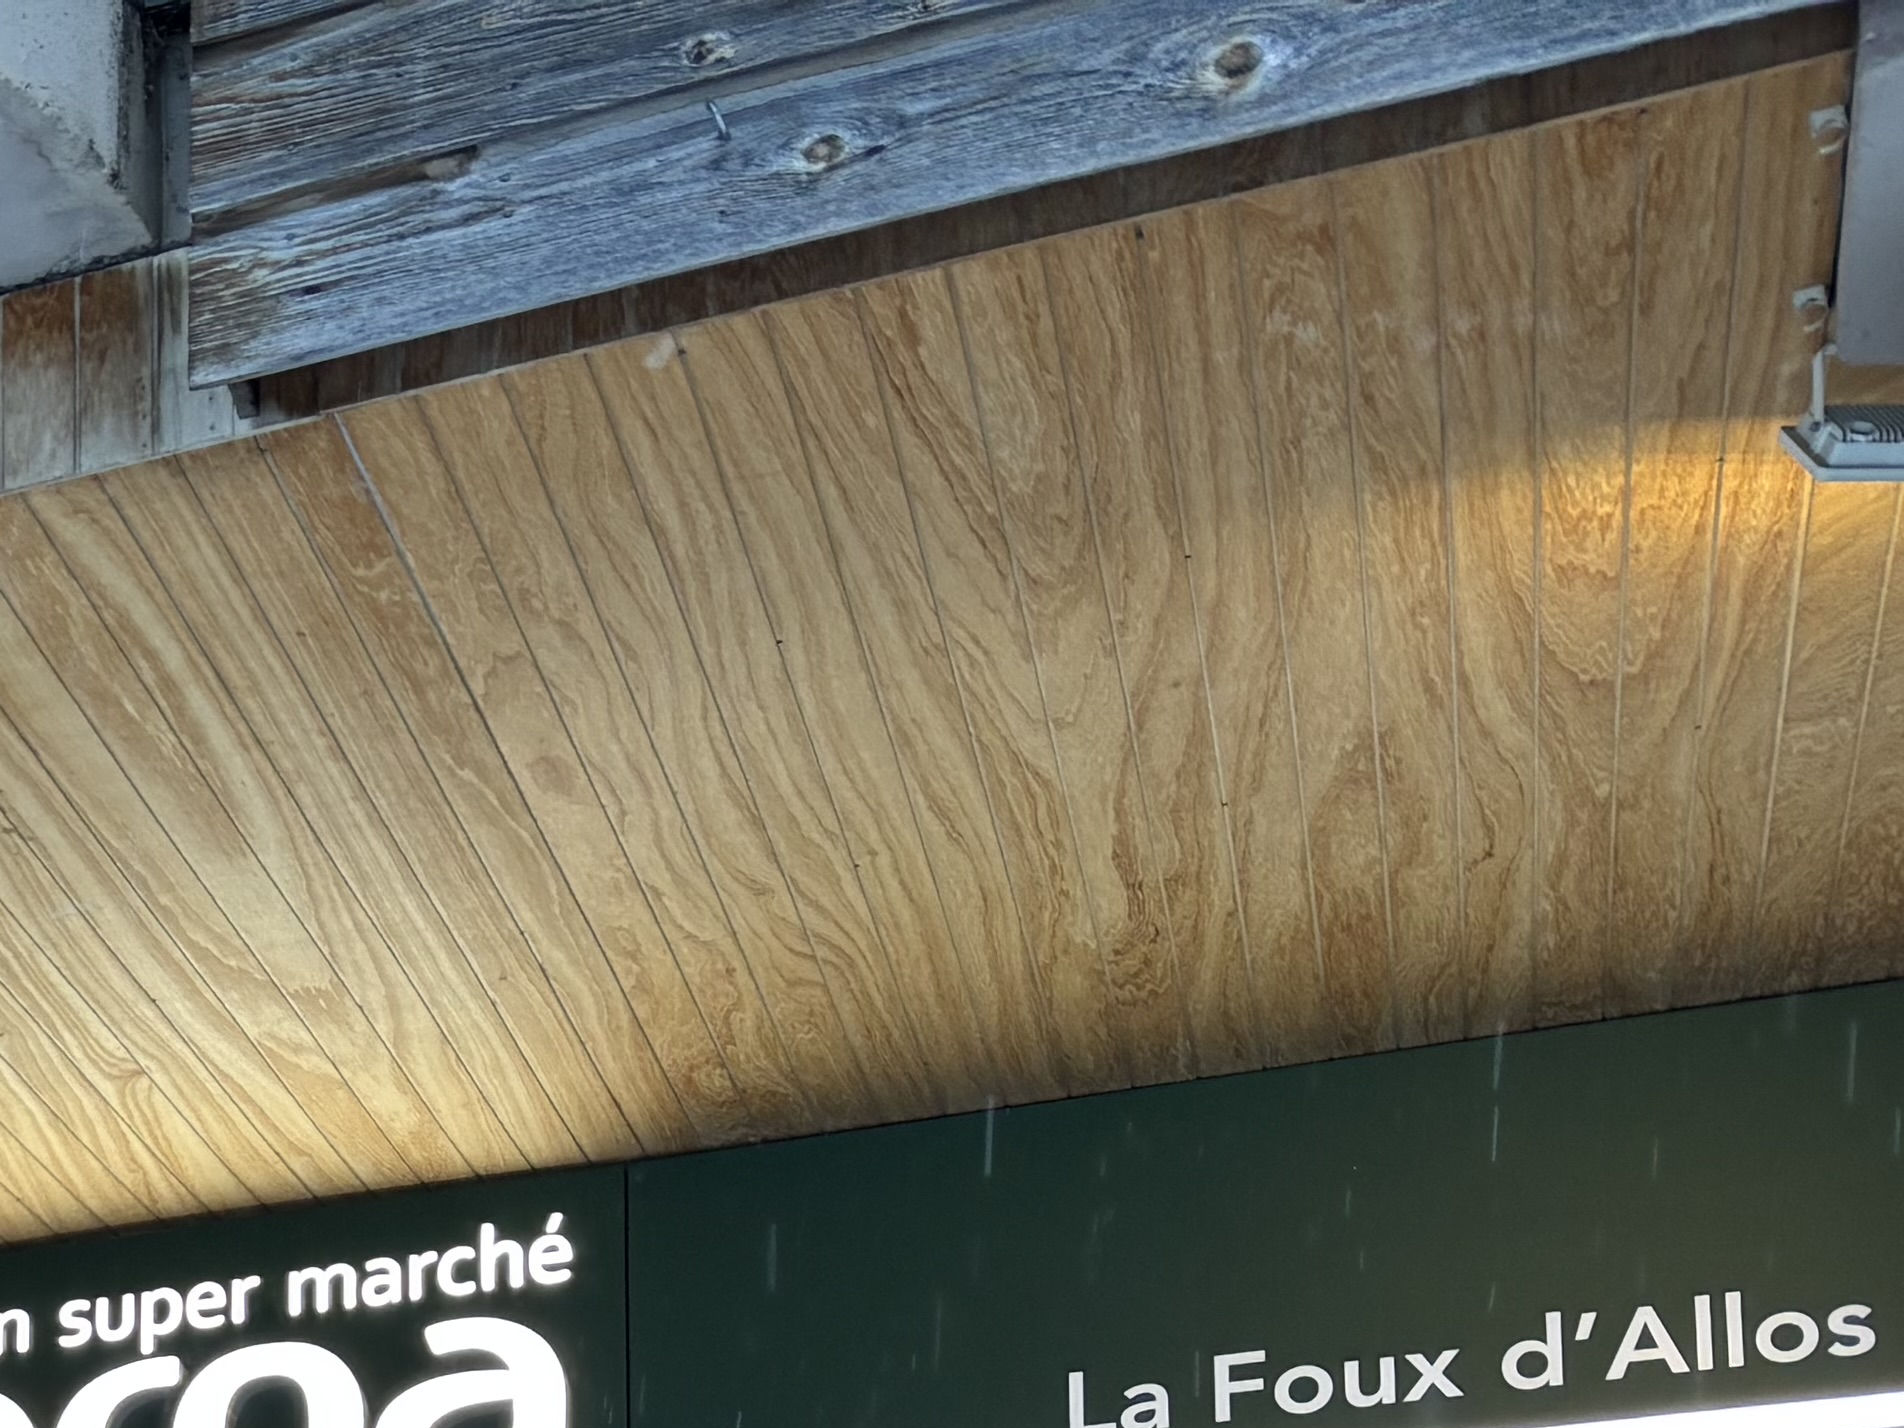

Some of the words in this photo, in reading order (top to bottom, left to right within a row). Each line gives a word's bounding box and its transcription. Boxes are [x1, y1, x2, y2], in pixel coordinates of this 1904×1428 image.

[57, 1276, 261, 1355] super
[287, 1211, 574, 1317] marché
[1213, 1348, 1464, 1423] Foux
[1501, 1289, 1877, 1391] d'Allos
